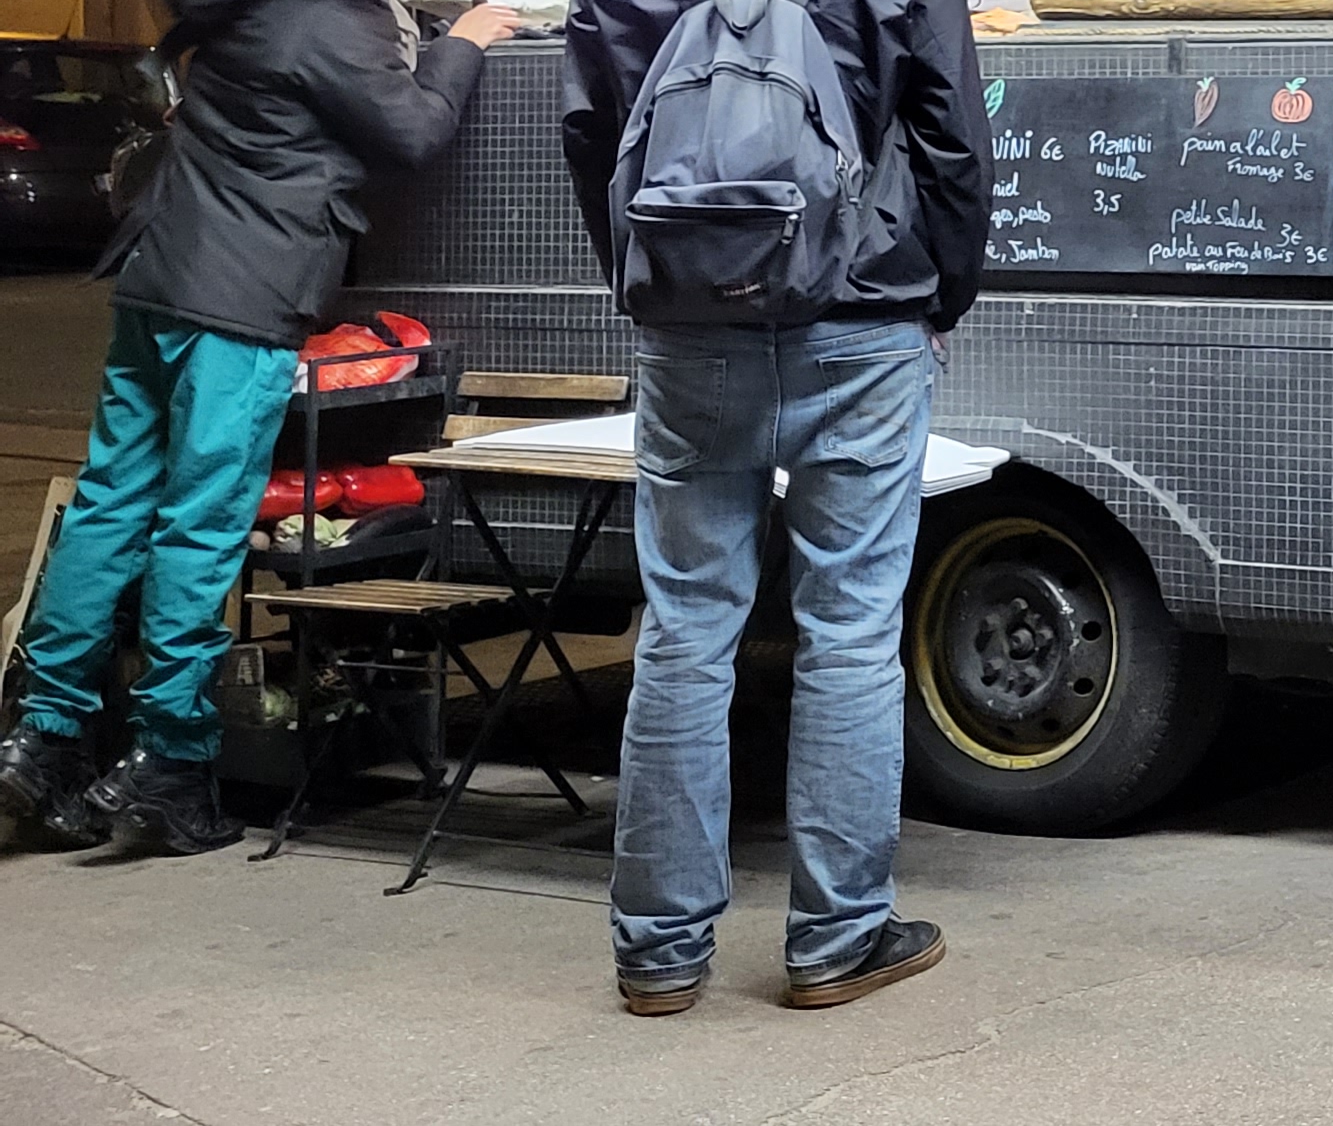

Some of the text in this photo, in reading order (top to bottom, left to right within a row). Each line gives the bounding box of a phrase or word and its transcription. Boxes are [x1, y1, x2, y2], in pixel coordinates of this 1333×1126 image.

[1179, 132, 1226, 167] pain
[1279, 132, 1308, 159] et
[1293, 161, 1315, 182] 3€
[1149, 232, 1201, 267] patate
[1204, 245, 1223, 258] au
[1304, 245, 1329, 265] 3€
[1276, 223, 1303, 248] 3€
